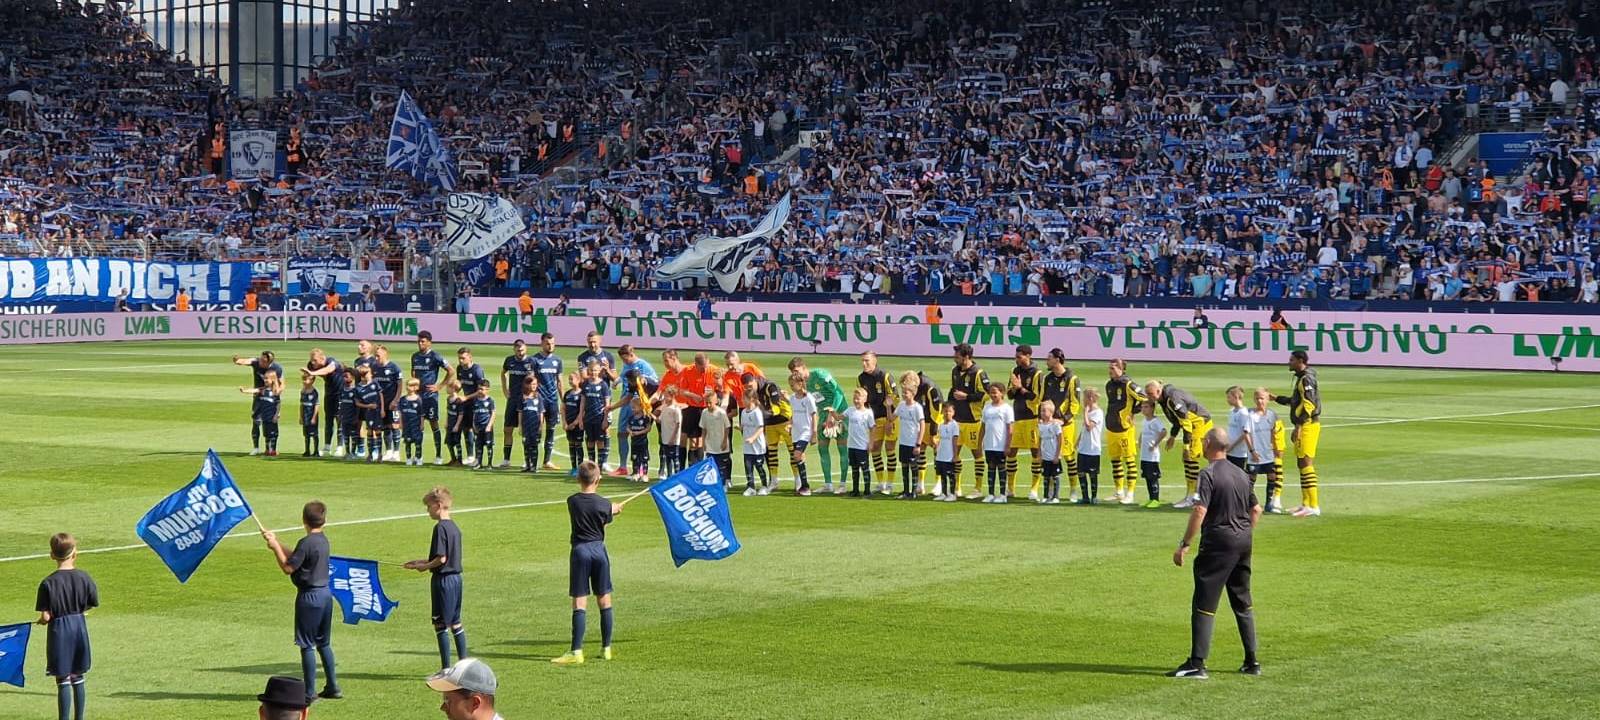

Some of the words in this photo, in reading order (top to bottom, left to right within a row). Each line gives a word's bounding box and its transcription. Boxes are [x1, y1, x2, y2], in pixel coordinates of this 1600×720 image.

[46, 258, 99, 296] AN
[199, 316, 356, 335] VERSICHERUNG
[663, 483, 730, 554] BOCHUM
